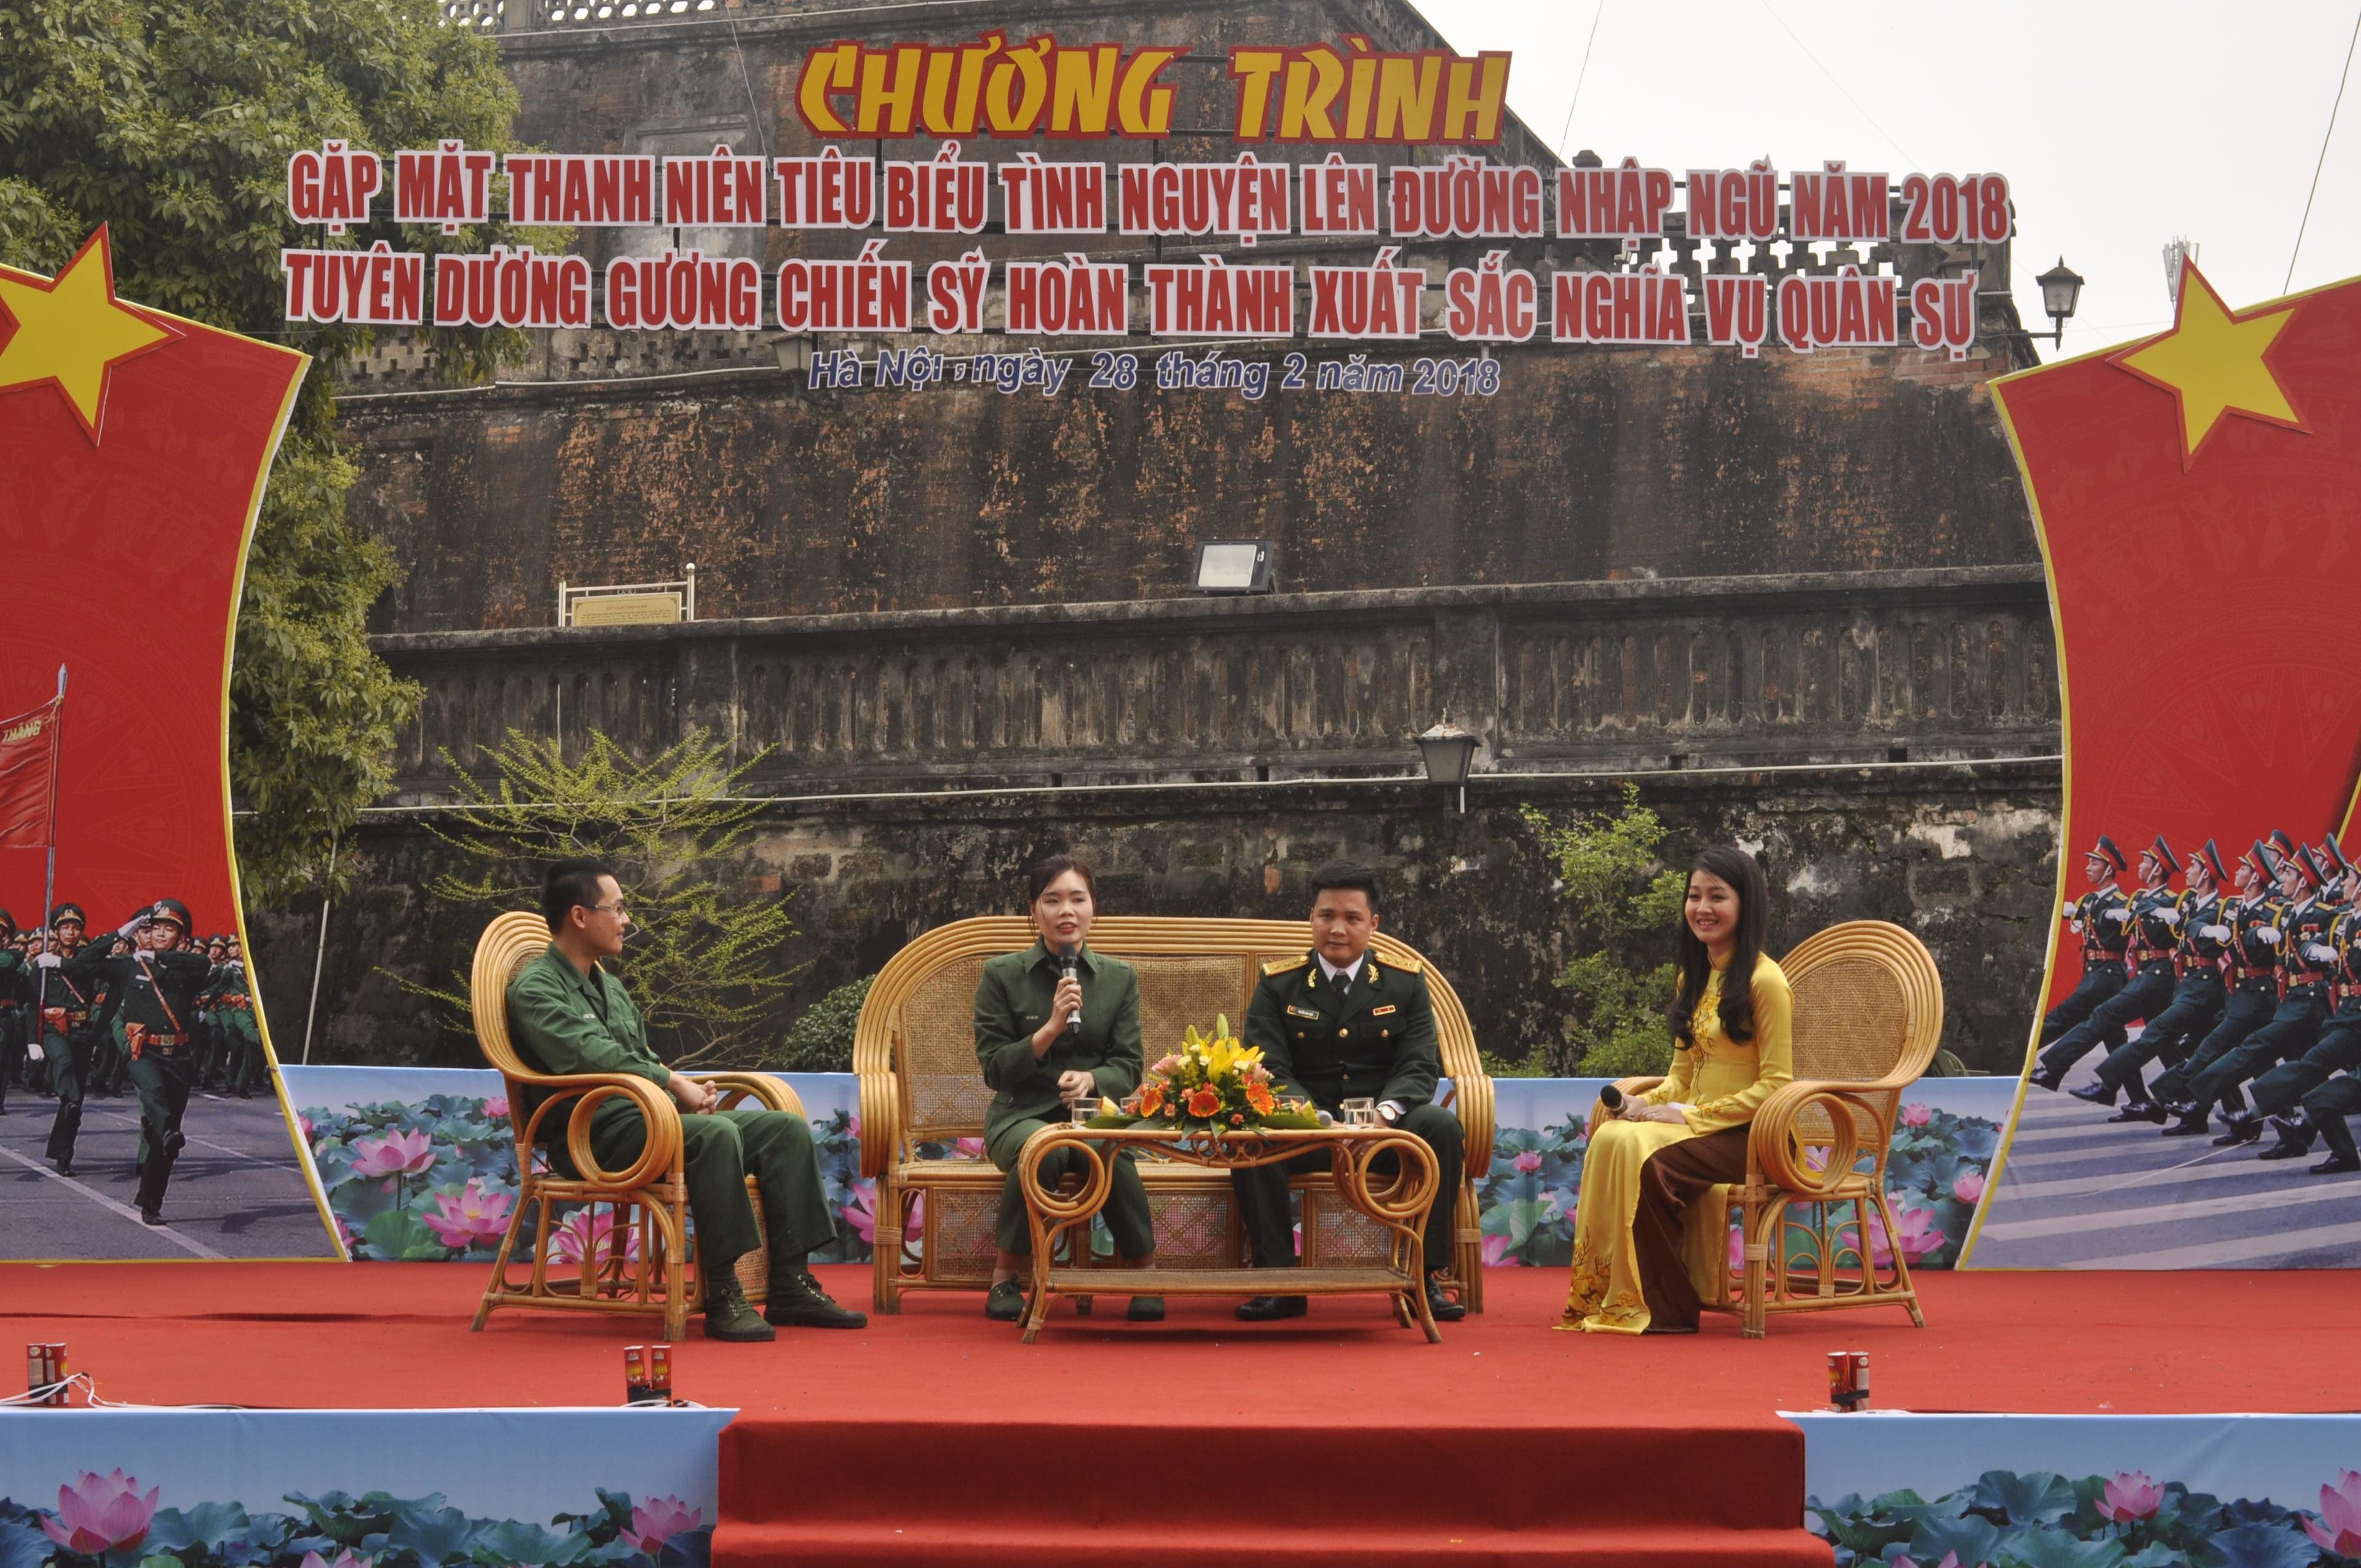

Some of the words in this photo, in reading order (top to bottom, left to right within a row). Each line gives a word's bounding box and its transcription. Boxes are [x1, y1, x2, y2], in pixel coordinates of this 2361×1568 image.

[800, 35, 1174, 134] CHƯƠNG
[1234, 37, 1508, 141] TRÌNH
[291, 143, 378, 232] GẶP
[398, 143, 491, 232] MẶT
[506, 159, 651, 223] THANH
[666, 146, 762, 224] NIÊN
[777, 148, 872, 225] TIÊU
[887, 141, 985, 231] BIỂU
[1001, 156, 1103, 231] TÌNH
[1123, 154, 1287, 244] NGUYỆN
[1304, 155, 1375, 231] LÊN
[1392, 157, 1540, 235] ĐƯỜNG
[1560, 159, 1671, 247] NHẬP
[1691, 162, 1776, 237] NGŨ
[1795, 167, 1888, 237] NĂM
[1905, 176, 2007, 240] 2018
[285, 243, 421, 321] TUYÊN
[435, 250, 587, 325] DƯƠNG
[609, 251, 757, 327] GƯƠNG
[780, 242, 907, 328] CHIẾN
[931, 255, 986, 330] SỸ
[1009, 256, 1125, 332] HOÀN
[1148, 258, 1291, 333] THÀNH
[1313, 248, 1423, 335] XUẤT
[1450, 253, 1533, 338] SẮC
[1556, 267, 1686, 341] NGHĨA
[1706, 279, 1765, 355] VỤ
[1781, 267, 1895, 349] QUÂN
[1915, 273, 1975, 358] SỰ
[809, 350, 861, 389] Hà
[973, 348, 1070, 395] ngày
[1091, 352, 1136, 389] 28
[1157, 351, 1268, 398] tháng
[1283, 353, 1305, 388] 2
[1318, 355, 1402, 392] năm
[1413, 358, 1499, 395] 2018
